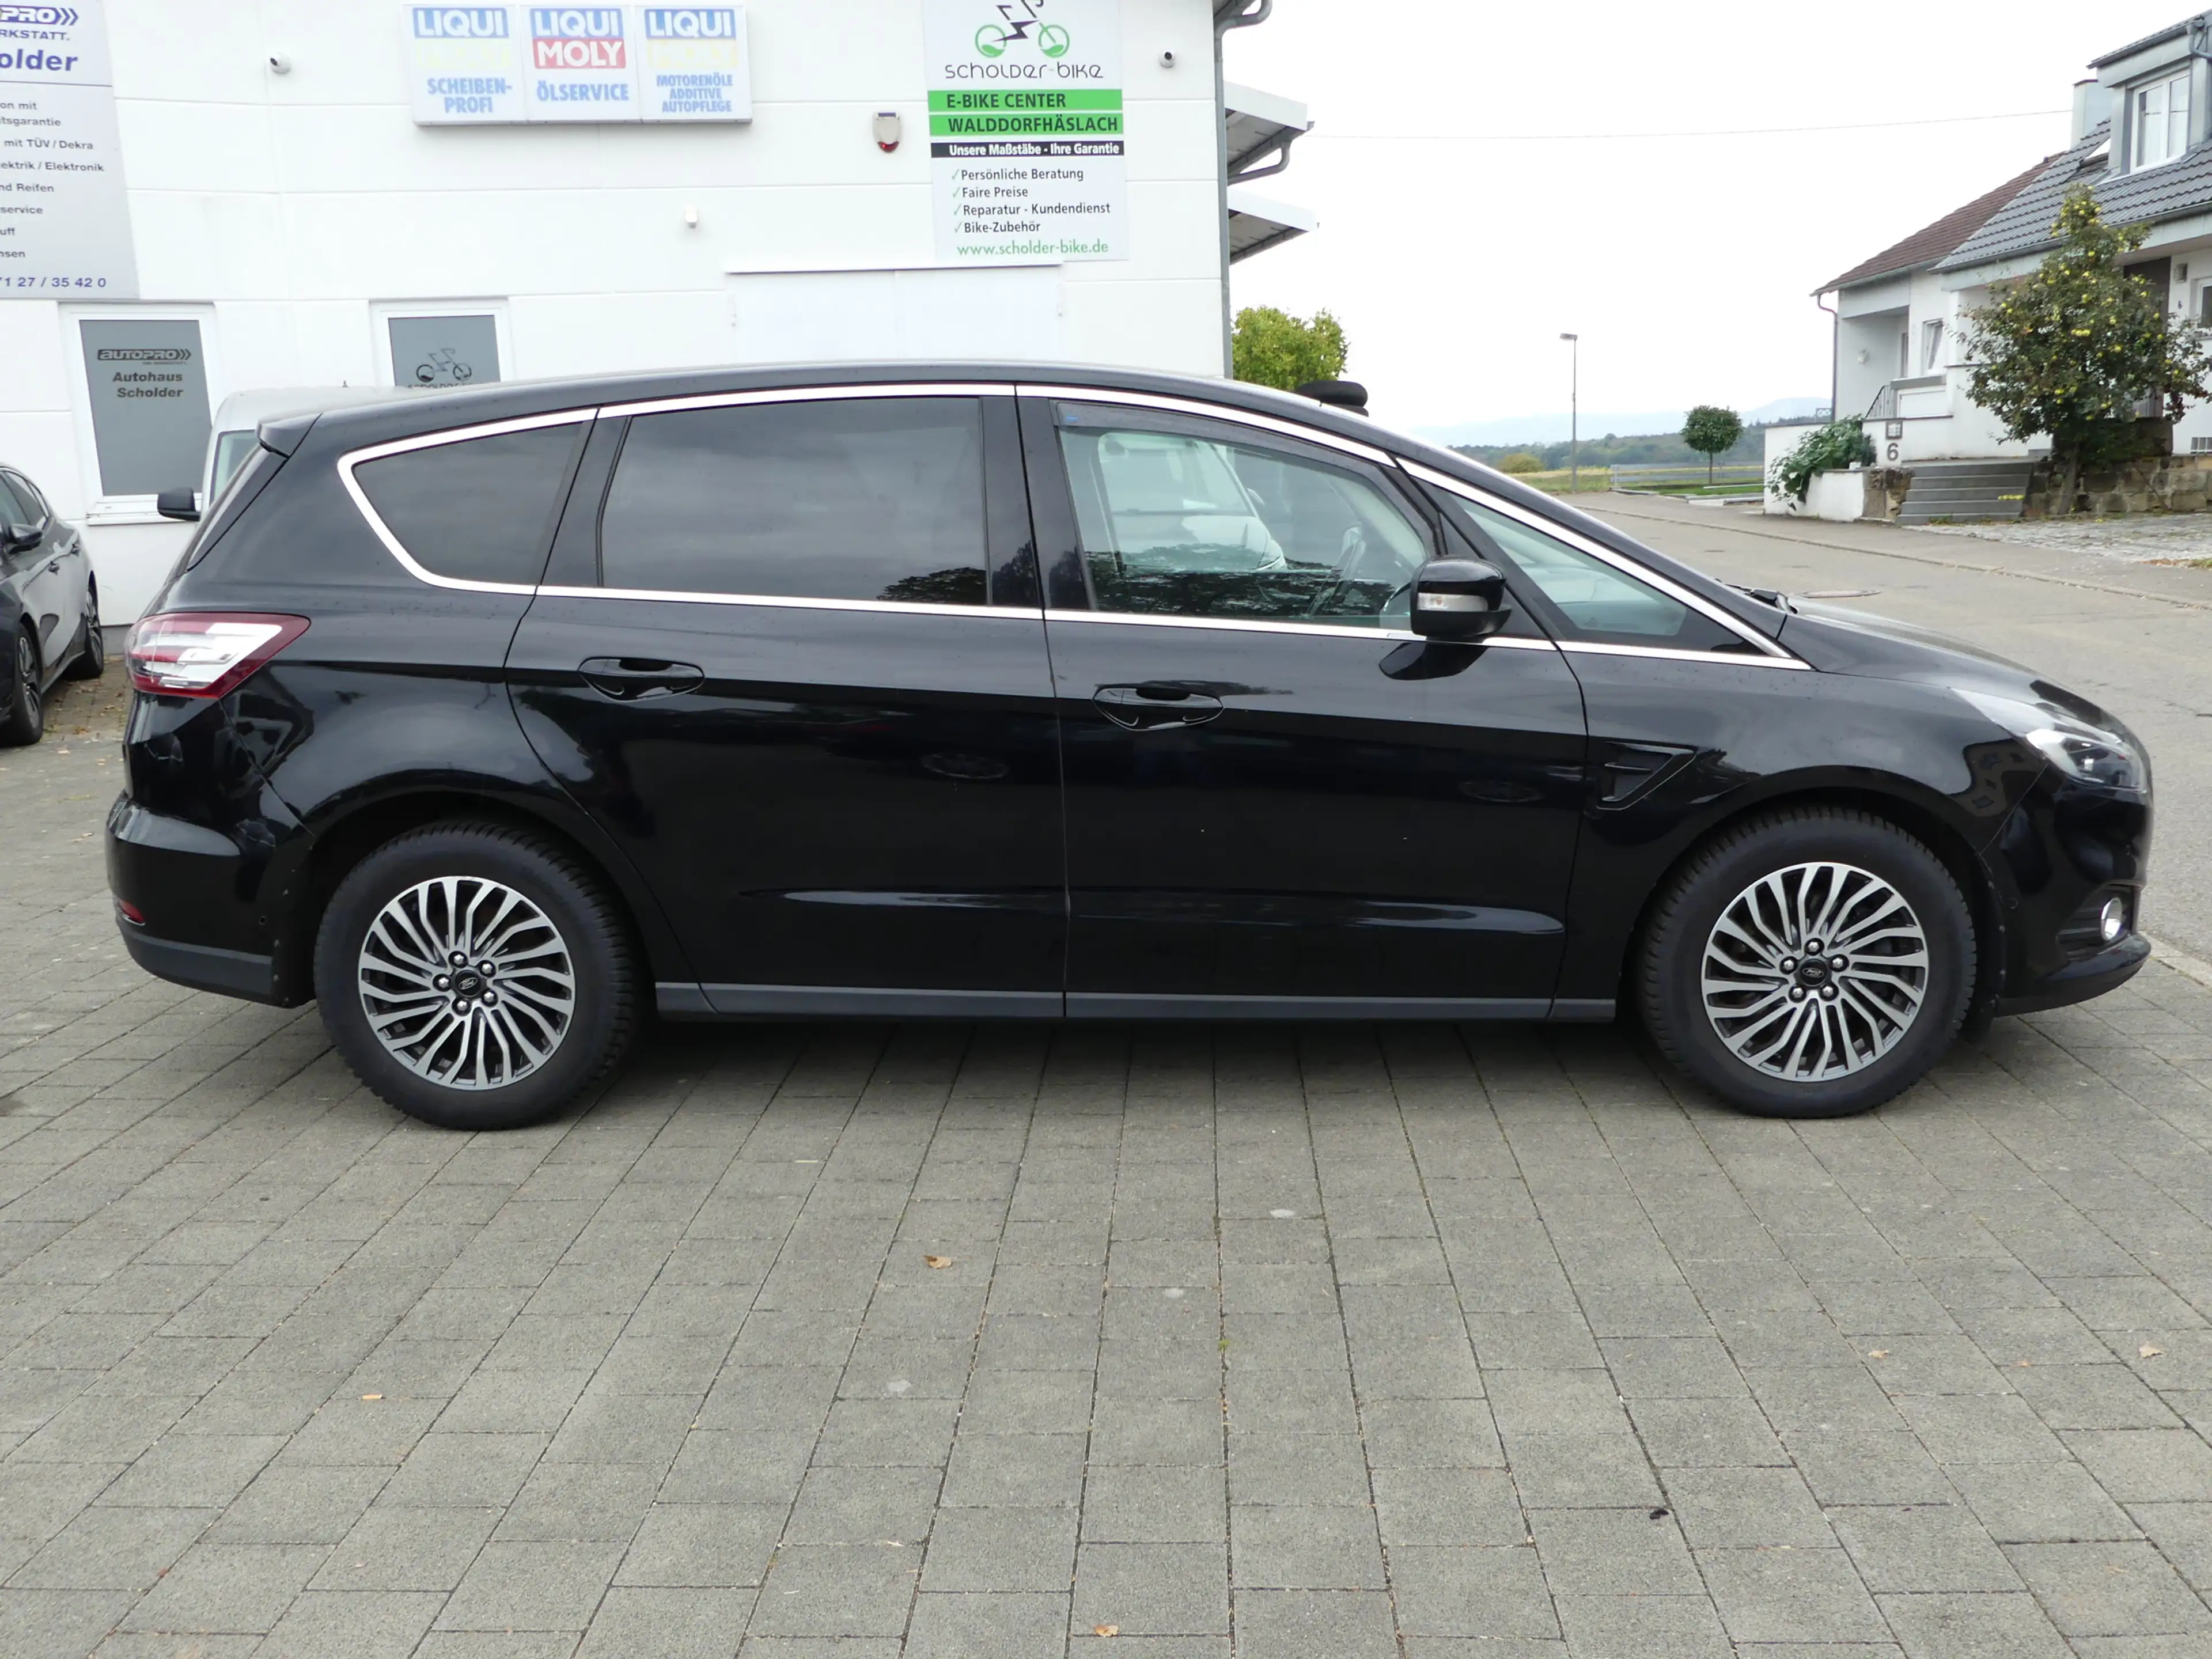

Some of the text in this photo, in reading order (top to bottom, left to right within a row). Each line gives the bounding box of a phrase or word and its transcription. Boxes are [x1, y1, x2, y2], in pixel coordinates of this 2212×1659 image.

[417, 9, 505, 37] LIQUI
[534, 10, 619, 38] LIQUI
[649, 10, 732, 38] LIQUI
[0, 48, 78, 71] older
[537, 40, 623, 67] MOLY
[427, 77, 512, 95] SCHEIBEN-
[656, 71, 733, 87] MOTORENÖLE
[536, 79, 629, 101] ÖLSERVICE
[669, 88, 722, 100] ADDITIVE
[18, 101, 37, 110] mit
[444, 96, 494, 113] PROFI
[662, 100, 733, 113] AUTOPFLEGE
[946, 93, 1066, 108] E-BIKE CENTER
[0, 116, 61, 126] tsgarantie
[948, 115, 1118, 132] WALDDORFHÄSLACH
[5, 139, 22, 147] mit
[26, 137, 50, 148] TÜV
[59, 140, 93, 149] Dekra
[949, 144, 986, 156] Unsere
[988, 143, 1041, 156] Maßstäbe
[1050, 143, 1071, 154] Ihre
[1074, 142, 1120, 154] Garantie
[45, 161, 104, 172] Elektronik
[961, 168, 1084, 181] Persönliche Beratung
[17, 183, 54, 192] Reifen
[962, 186, 1028, 198] Faire Preise
[963, 204, 1021, 218] Reparatur
[1031, 202, 1111, 214] Kundendienst
[964, 221, 1041, 233] Bike-Zubehör
[956, 238, 1108, 255] www.scholder-bike.de
[18, 277, 35, 287] 27
[52, 277, 69, 287] 35
[75, 278, 93, 287] 42
[98, 278, 107, 287] 0
[112, 372, 183, 382] Autohaus
[117, 388, 184, 397] Scholder
[1887, 442, 1899, 461] 6
